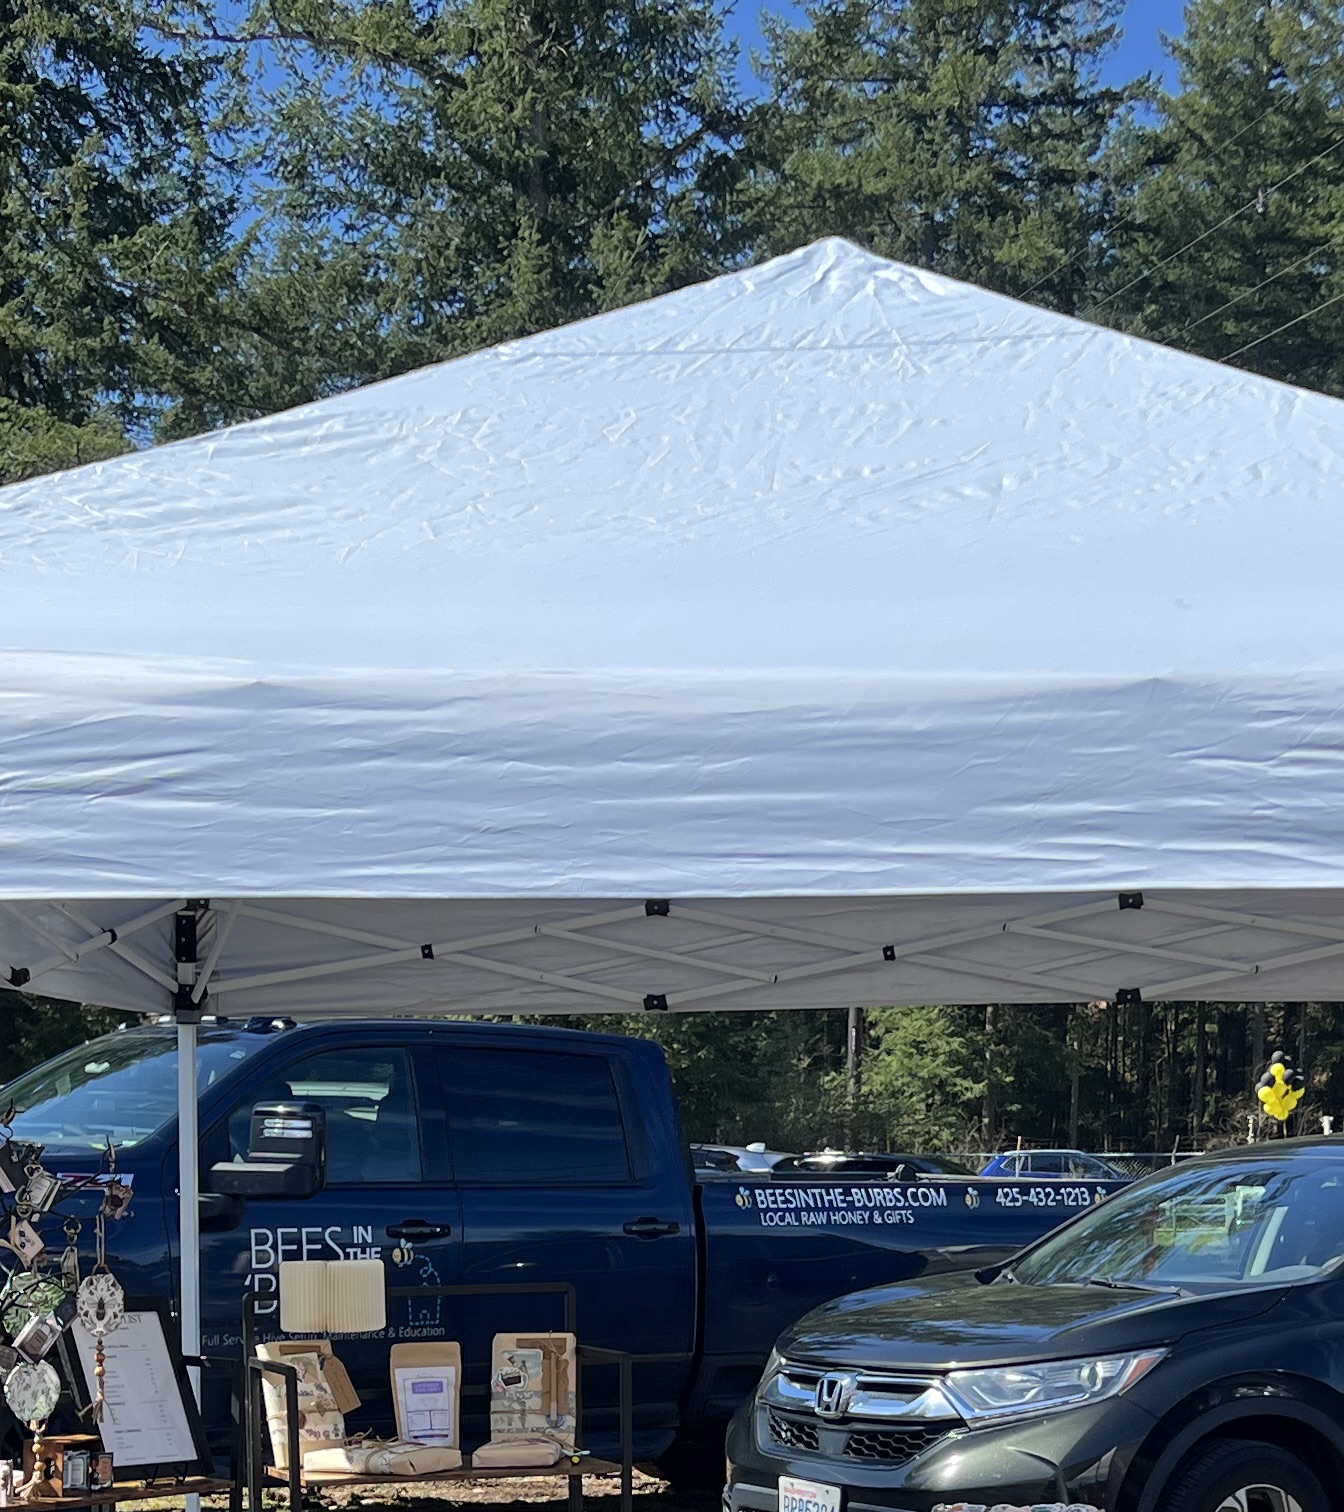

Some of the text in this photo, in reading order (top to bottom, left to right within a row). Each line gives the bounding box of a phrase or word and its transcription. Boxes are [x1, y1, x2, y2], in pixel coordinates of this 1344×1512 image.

[755, 1187, 1090, 1209] BEESINTHE-BURBS.COM 425-432-1213
[760, 1210, 915, 1227] LOCAL RAW HONEY & GIFTS
[250, 1226, 373, 1268] BEES IN
[202, 1335, 220, 1347] Full
[222, 1333, 260, 1346] Serve
[387, 1327, 396, 1338] &
[398, 1326, 446, 1338] Education
